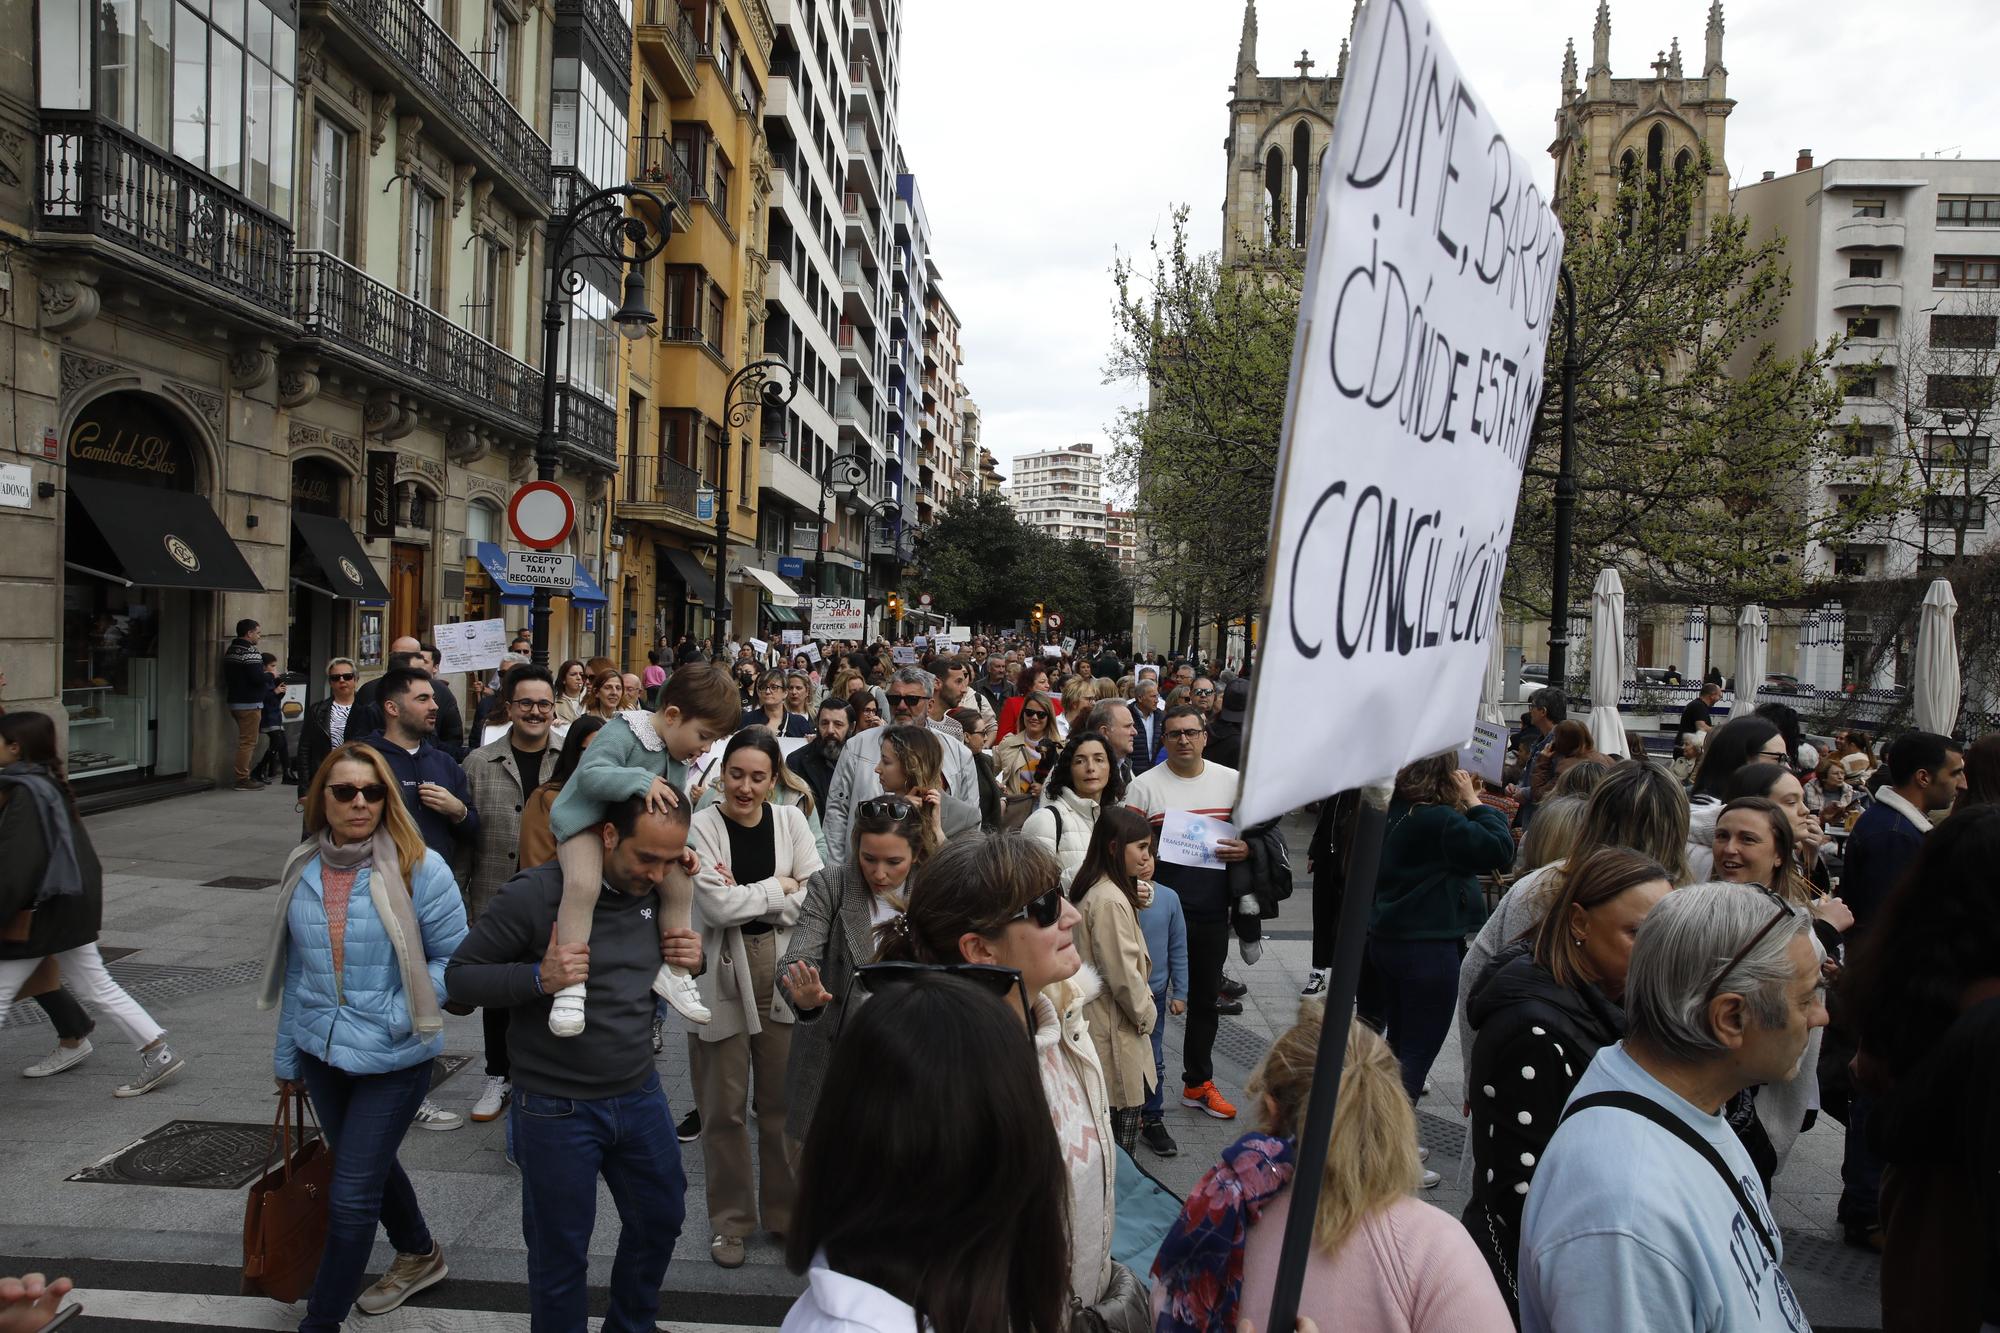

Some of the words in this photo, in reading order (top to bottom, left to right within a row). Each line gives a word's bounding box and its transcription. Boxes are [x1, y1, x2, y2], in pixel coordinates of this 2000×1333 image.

[70, 421, 123, 464] Camilo
[137, 436, 177, 474] Blas
[0, 480, 30, 499] ADONGA
[520, 554, 562, 565] EXCEPTO
[526, 565, 546, 574] TAXI
[550, 566, 556, 574] Y
[509, 573, 552, 584] RECOGIDA
[553, 576, 571, 586] RSU
[816, 598, 851, 610] SESPA
[1163, 838, 1208, 852] TRANSPARENCIA
